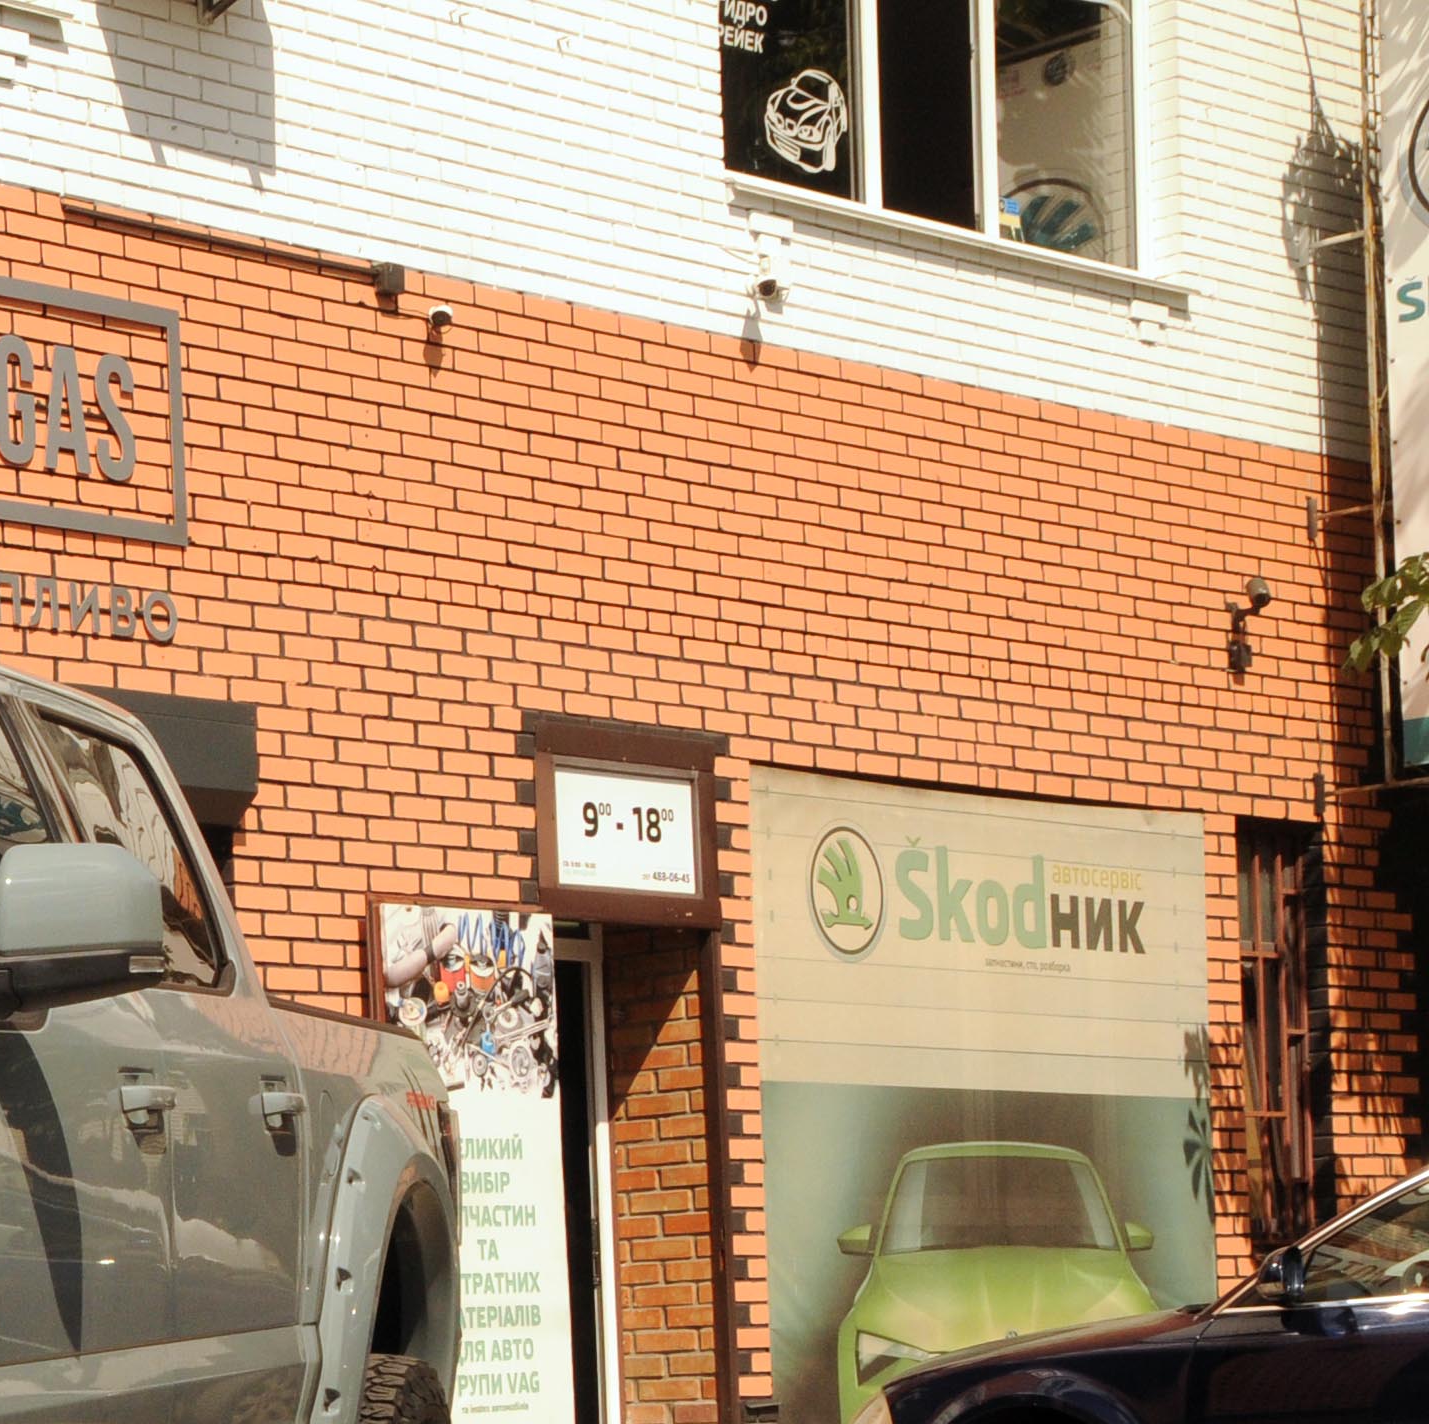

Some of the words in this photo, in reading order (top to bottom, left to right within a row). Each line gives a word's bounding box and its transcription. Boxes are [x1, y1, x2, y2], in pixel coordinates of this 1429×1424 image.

[722, 0, 768, 27] ИДРО
[460, 1171, 511, 1195] ВИБІР
[461, 1204, 537, 1228] ПЧАСТИН
[476, 1238, 500, 1262] ТА
[460, 1271, 542, 1295] ТРАТНИХ
[459, 1304, 542, 1329] АТЕРІАЛІВ
[491, 1337, 535, 1362] АВТО
[458, 1373, 503, 1397] РУПИ
[506, 1370, 541, 1394] VAG
